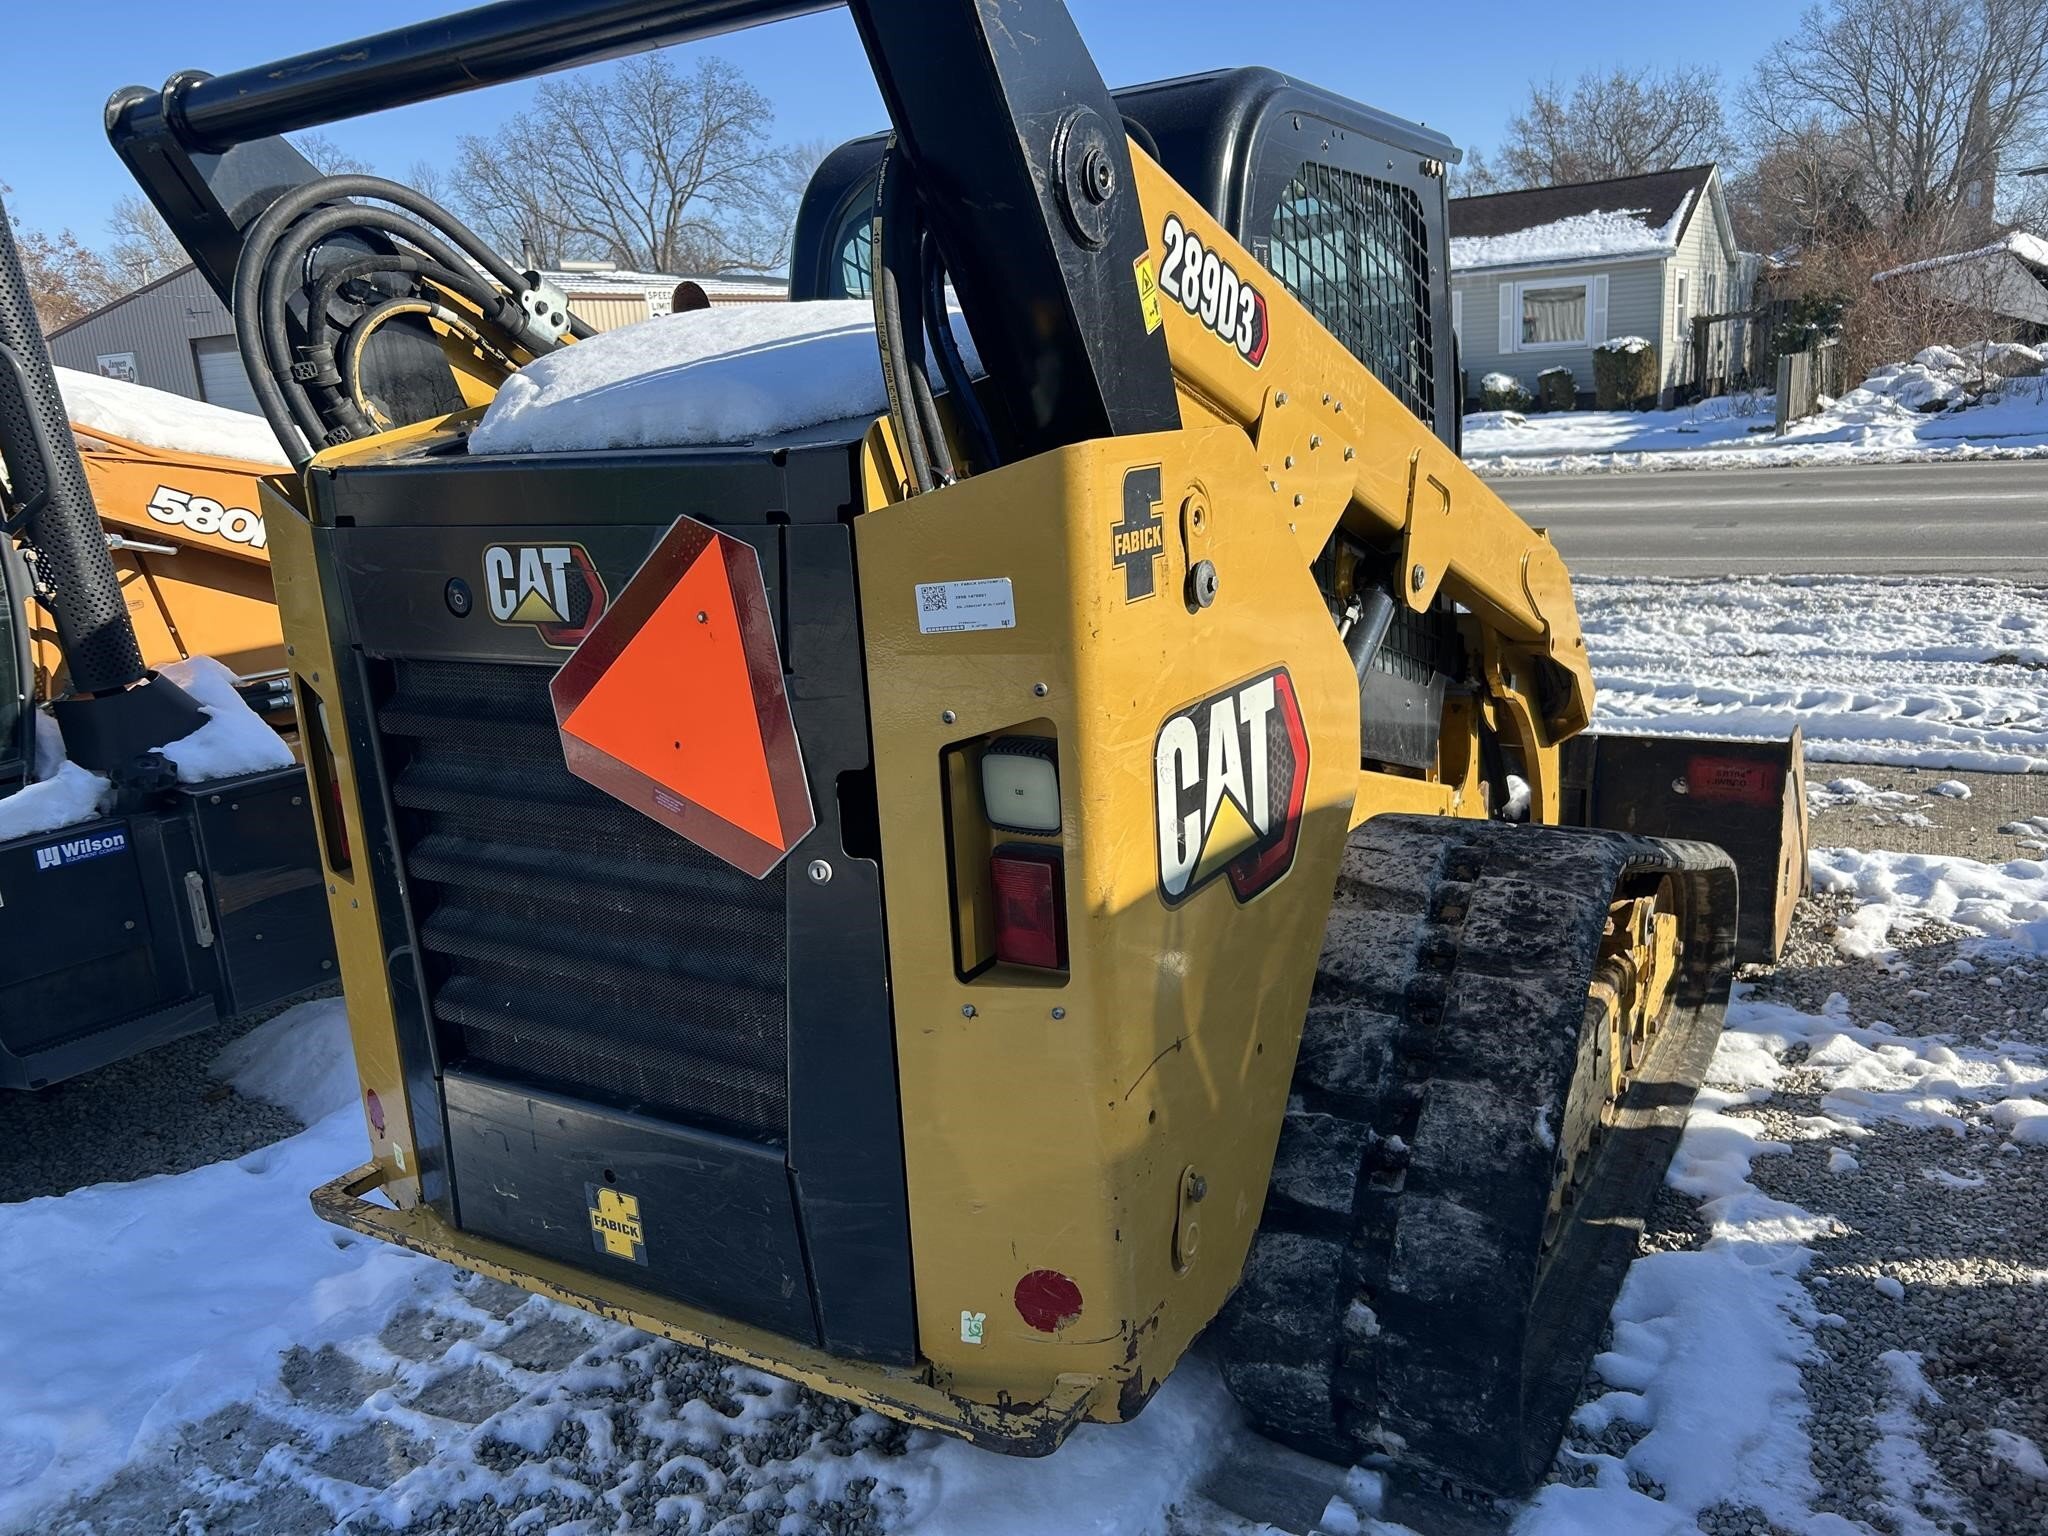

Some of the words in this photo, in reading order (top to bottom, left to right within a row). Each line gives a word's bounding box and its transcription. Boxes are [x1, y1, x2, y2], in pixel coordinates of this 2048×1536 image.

[1160, 218, 1255, 354] 289D3
[651, 302, 671, 311] LIMIT
[1114, 525, 1162, 557] FABICK
[485, 546, 571, 622] CAT
[1156, 676, 1275, 896] CAT
[60, 834, 125, 858] Wilson
[593, 1215, 639, 1239] FABICK
